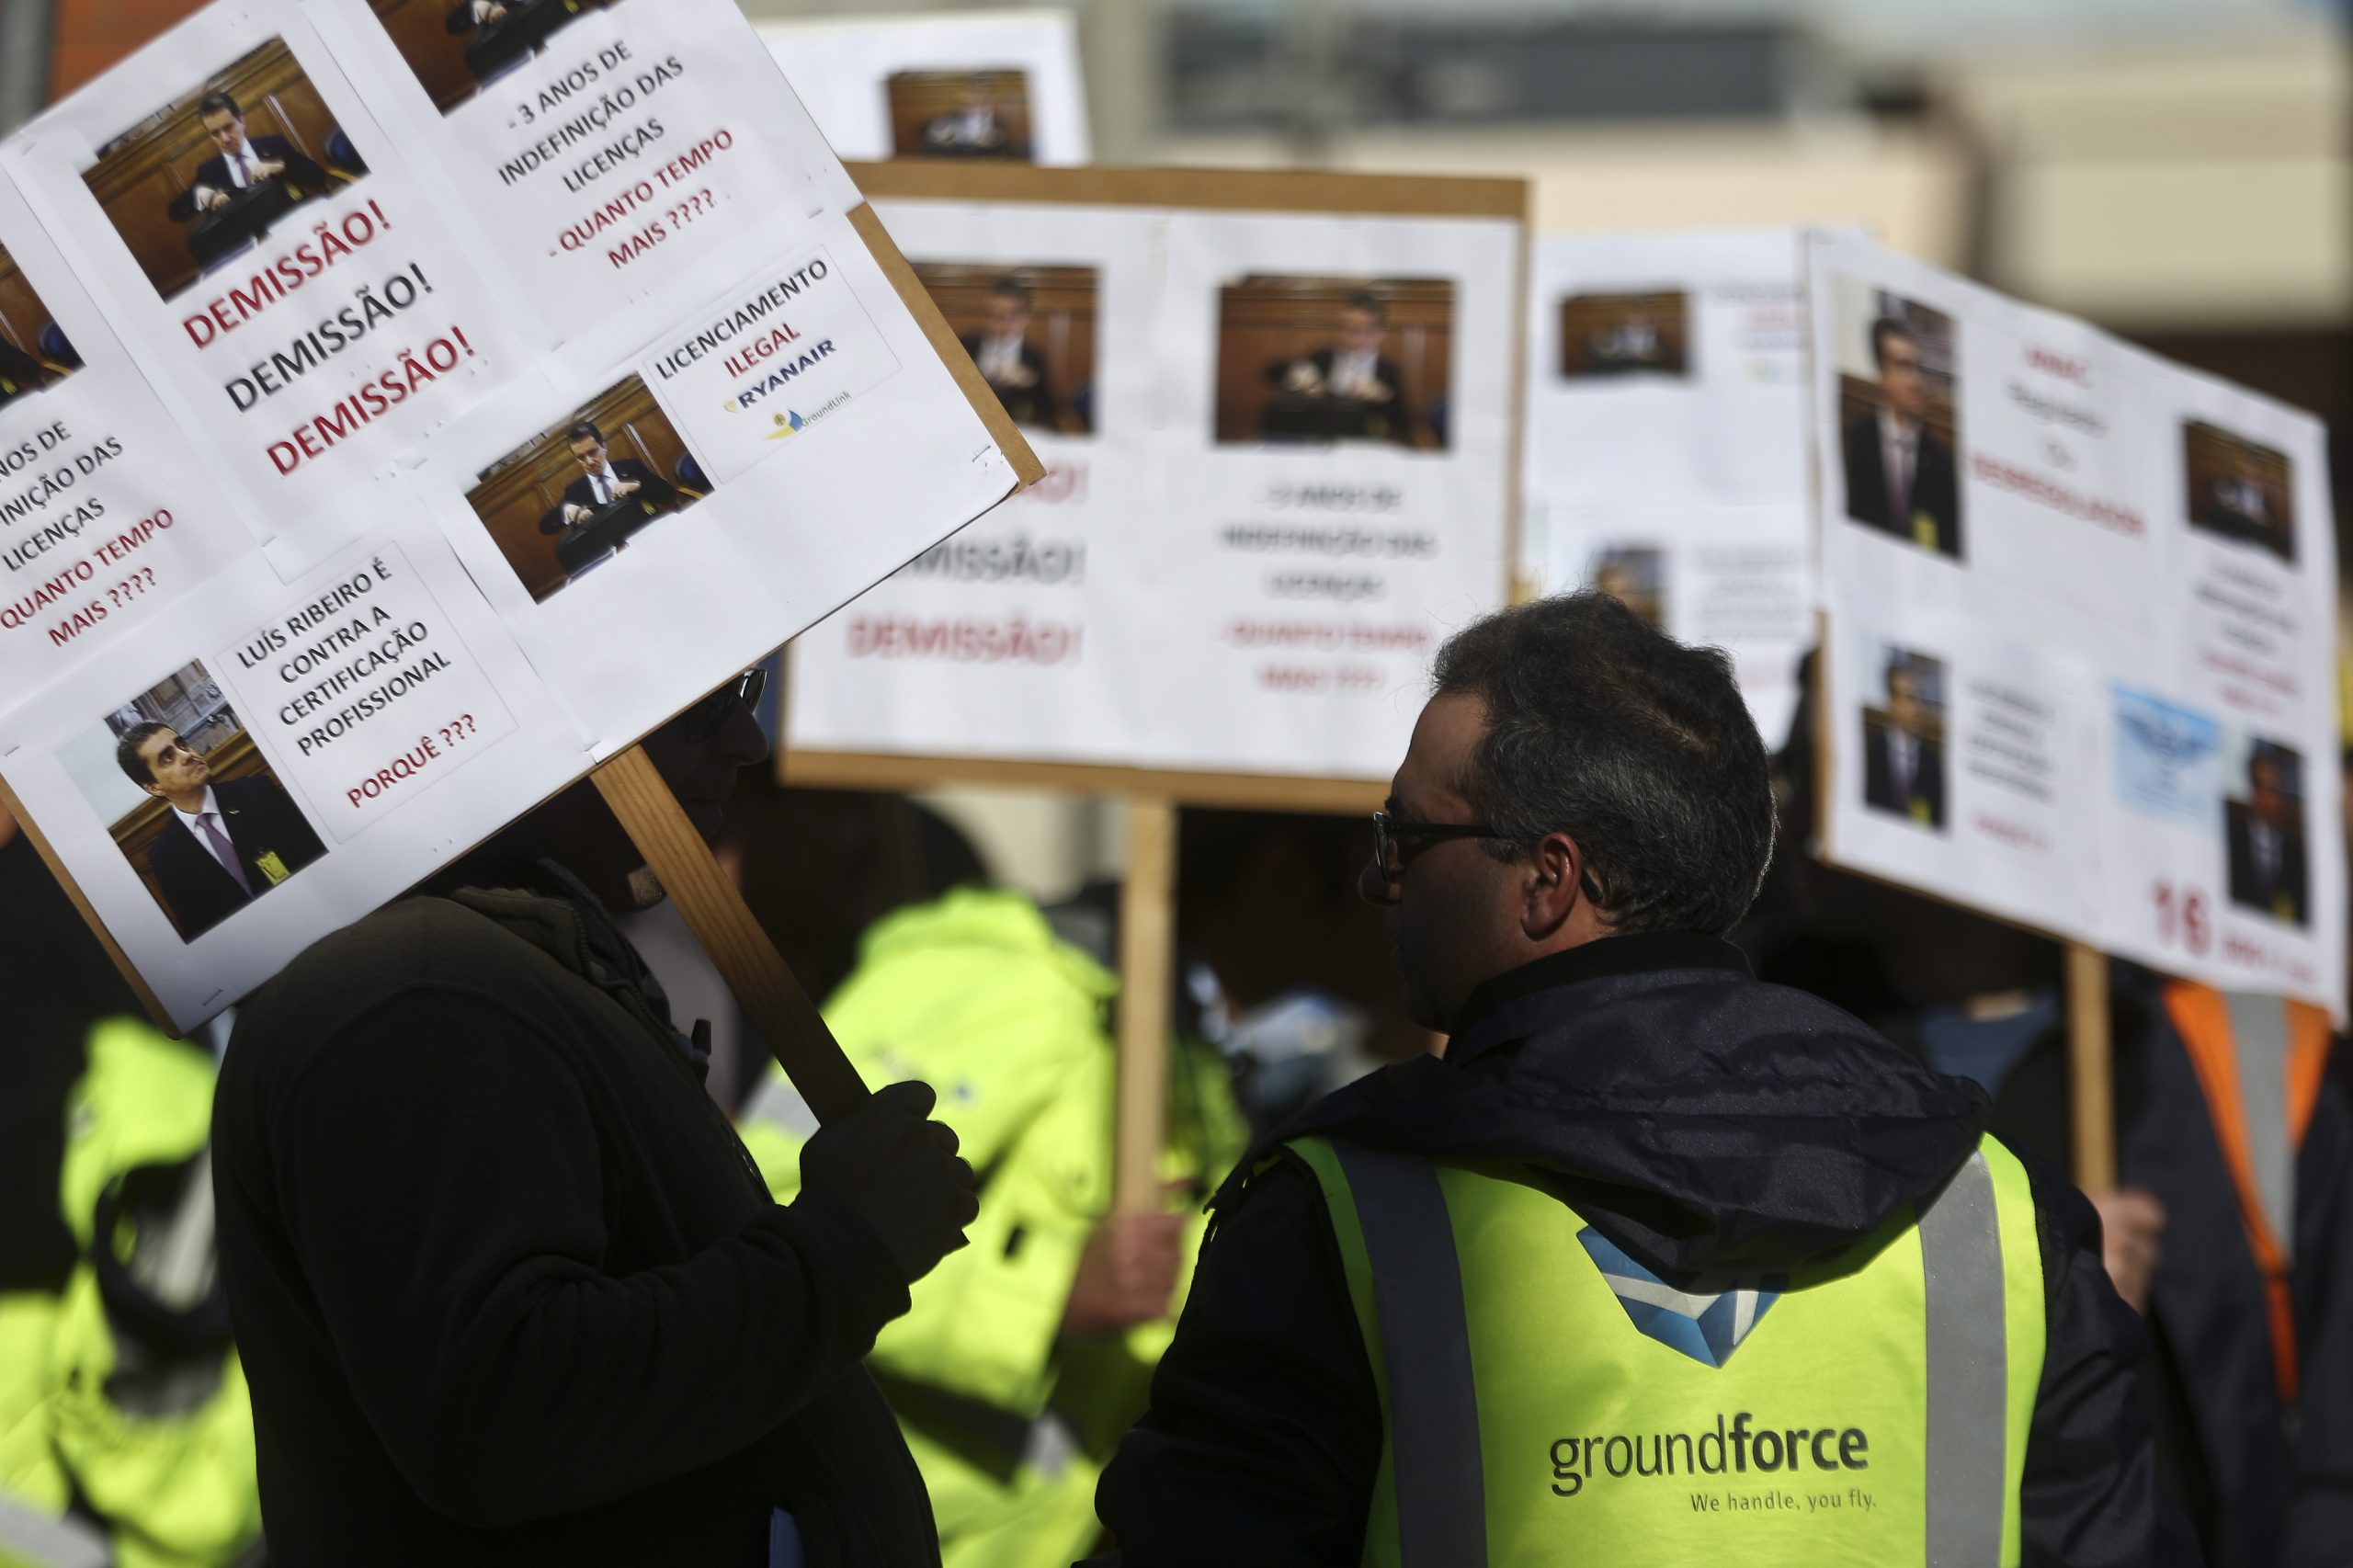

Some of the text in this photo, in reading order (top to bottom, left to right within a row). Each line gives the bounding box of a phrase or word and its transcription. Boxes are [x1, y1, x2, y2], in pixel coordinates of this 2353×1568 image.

[497, 56, 685, 186] INDEFINIÇÃO DAS
[518, 103, 535, 125] 3
[537, 62, 599, 113] ANOS
[599, 40, 632, 72] DE
[560, 182, 654, 252] QUANTO
[654, 129, 733, 188] TEMPO
[563, 117, 665, 194] LICENÇAS
[608, 188, 717, 269] MAIS ????
[182, 199, 392, 349] DEMISSÃO!
[225, 262, 433, 414] DEMISSÃO!
[654, 259, 828, 381] LICENCIAMENTO
[722, 322, 801, 380] ILEGAL
[266, 325, 475, 477] DEMISSÃO!
[737, 339, 837, 409] RYANAIR
[0, 421, 73, 483] NOS DE
[0, 437, 123, 527] INIÇÃO DAS
[0, 508, 174, 630] QUANTO TEMPO
[3, 497, 106, 573] LICENÇAS
[48, 566, 157, 648] MAIS ????
[237, 556, 392, 669] LUÍS RIBEIRO É
[279, 606, 392, 684] CONTRA A
[279, 621, 428, 726] CERTIFICAÇÃO
[296, 651, 451, 756] PROFISSIONAL
[347, 713, 476, 809] PORQUÊ ???
[1550, 1411, 1870, 1497] groundforce
[1690, 1489, 1877, 1514] We handle, you fly.
